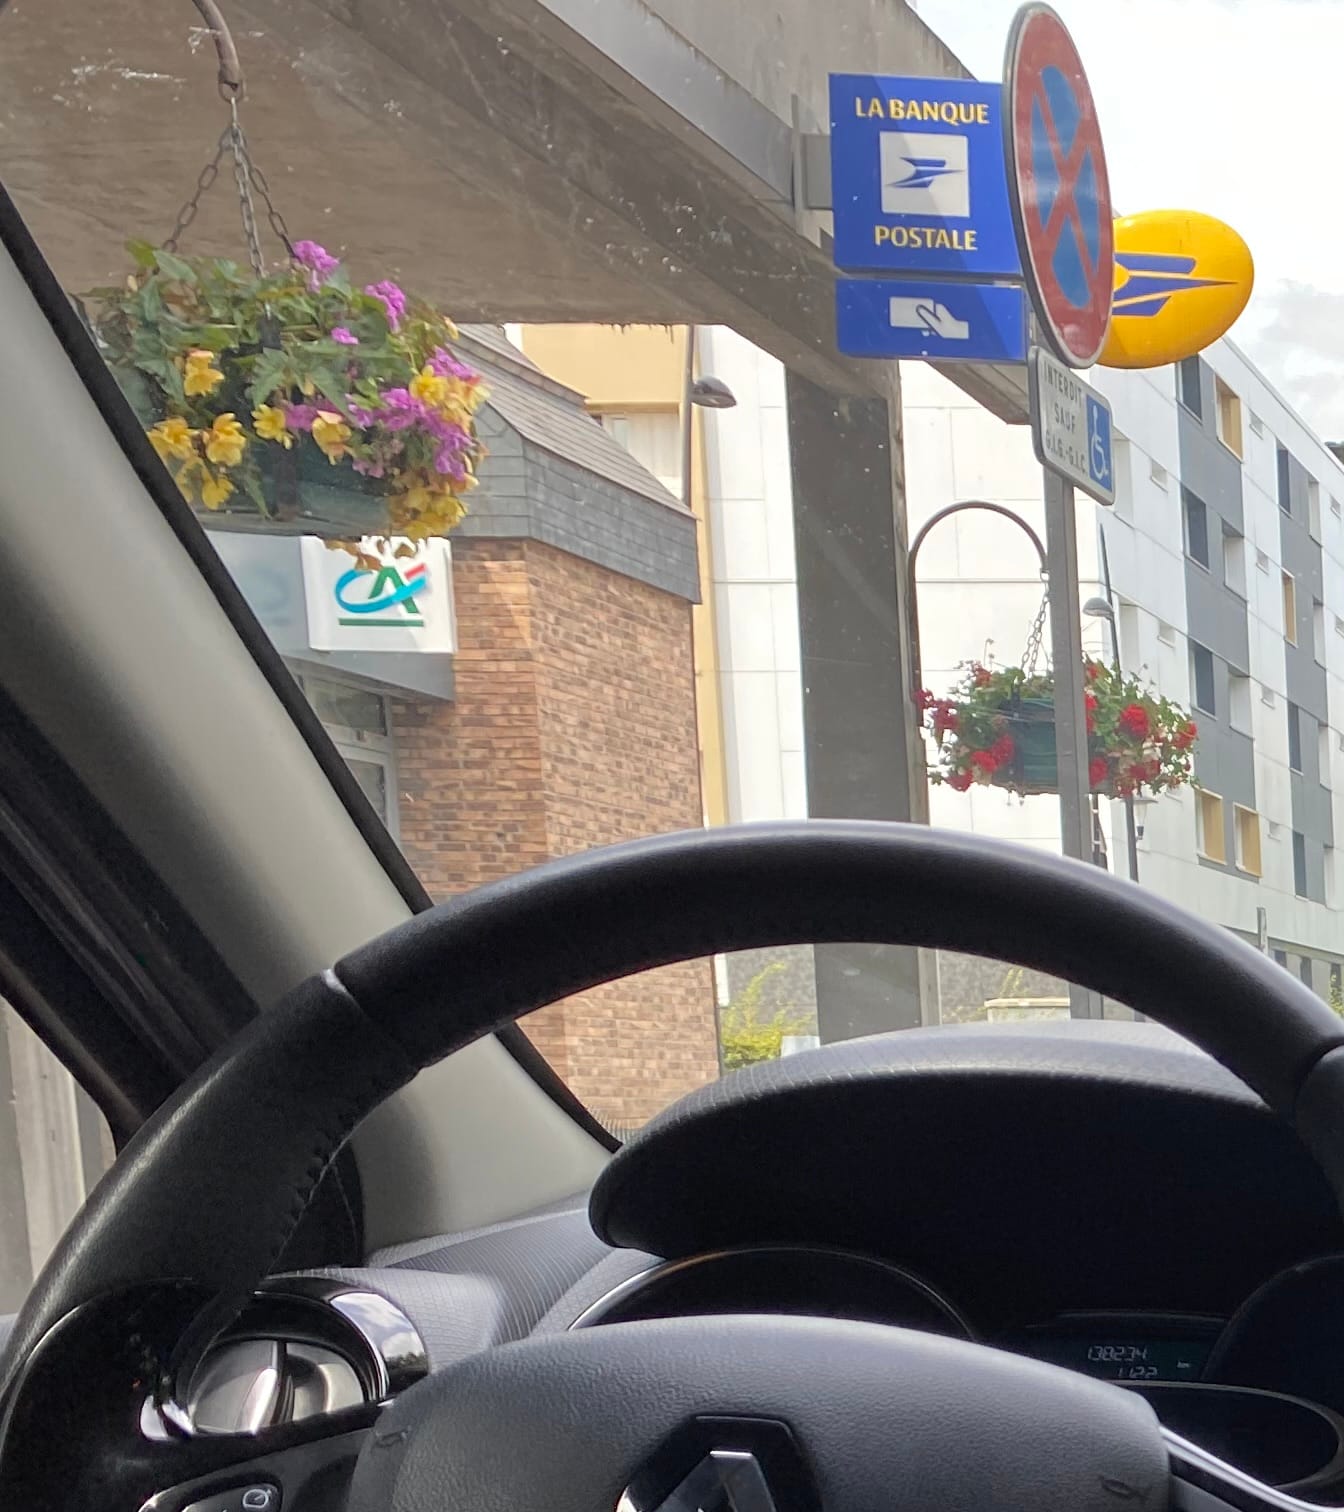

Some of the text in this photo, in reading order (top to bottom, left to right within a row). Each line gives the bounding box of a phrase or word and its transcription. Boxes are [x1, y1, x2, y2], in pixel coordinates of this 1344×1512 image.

[855, 97, 990, 126] LA BANQUE
[874, 224, 978, 251] POSTALE
[1043, 360, 1082, 408] INTERDIT
[1054, 402, 1076, 434] SAUF
